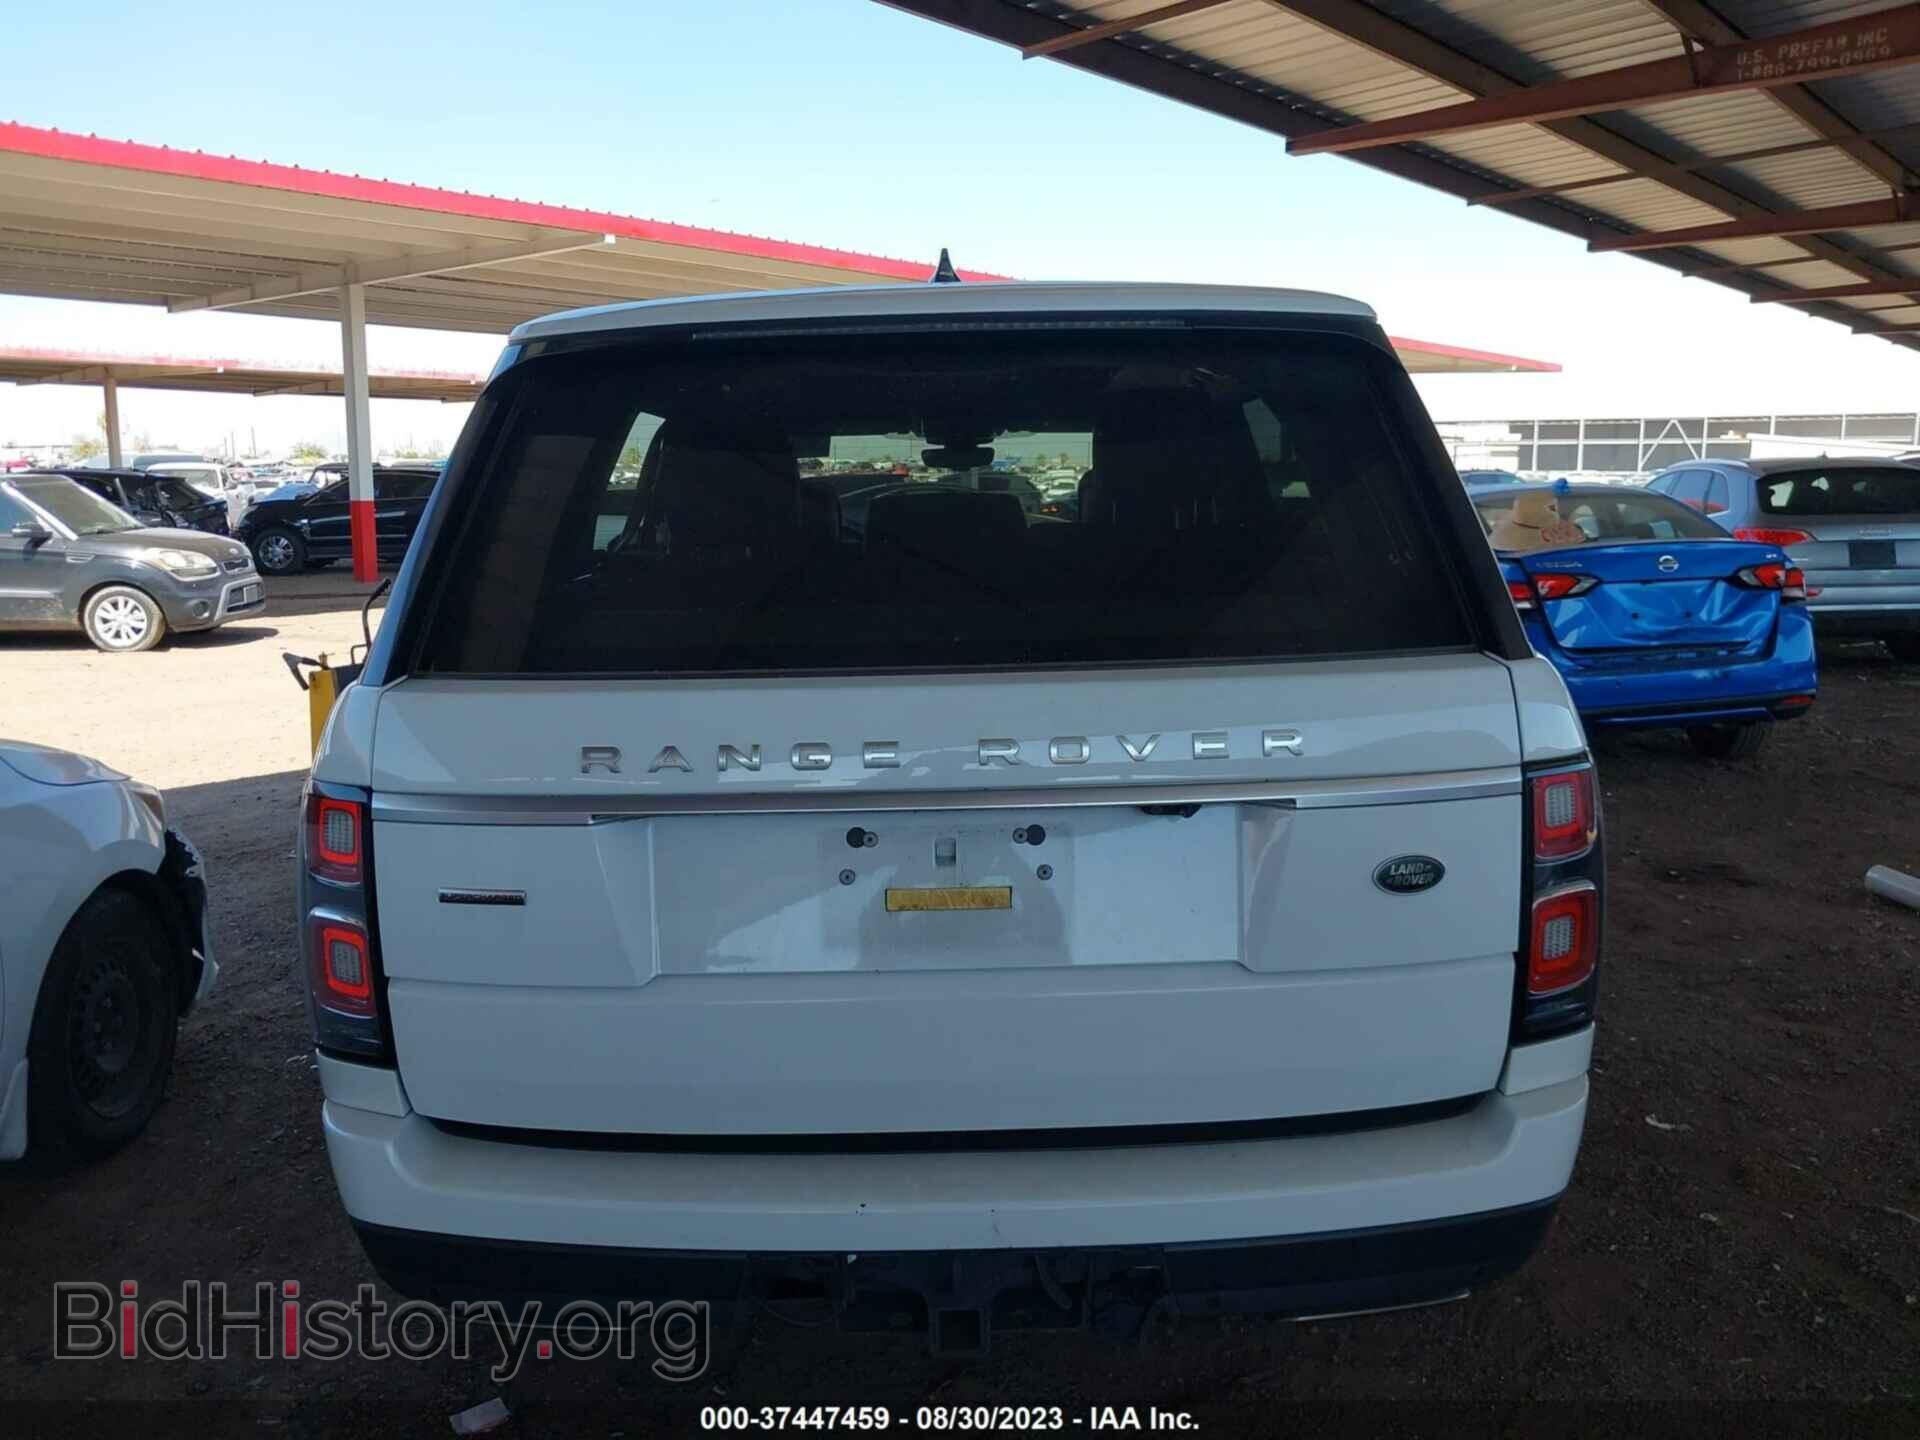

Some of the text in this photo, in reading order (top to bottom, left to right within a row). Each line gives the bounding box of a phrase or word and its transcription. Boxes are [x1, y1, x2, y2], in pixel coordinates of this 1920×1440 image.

[1736, 48, 1768, 66] U.S.
[1856, 27, 1888, 47] INC
[581, 728, 1304, 774] RANGE ROVER
